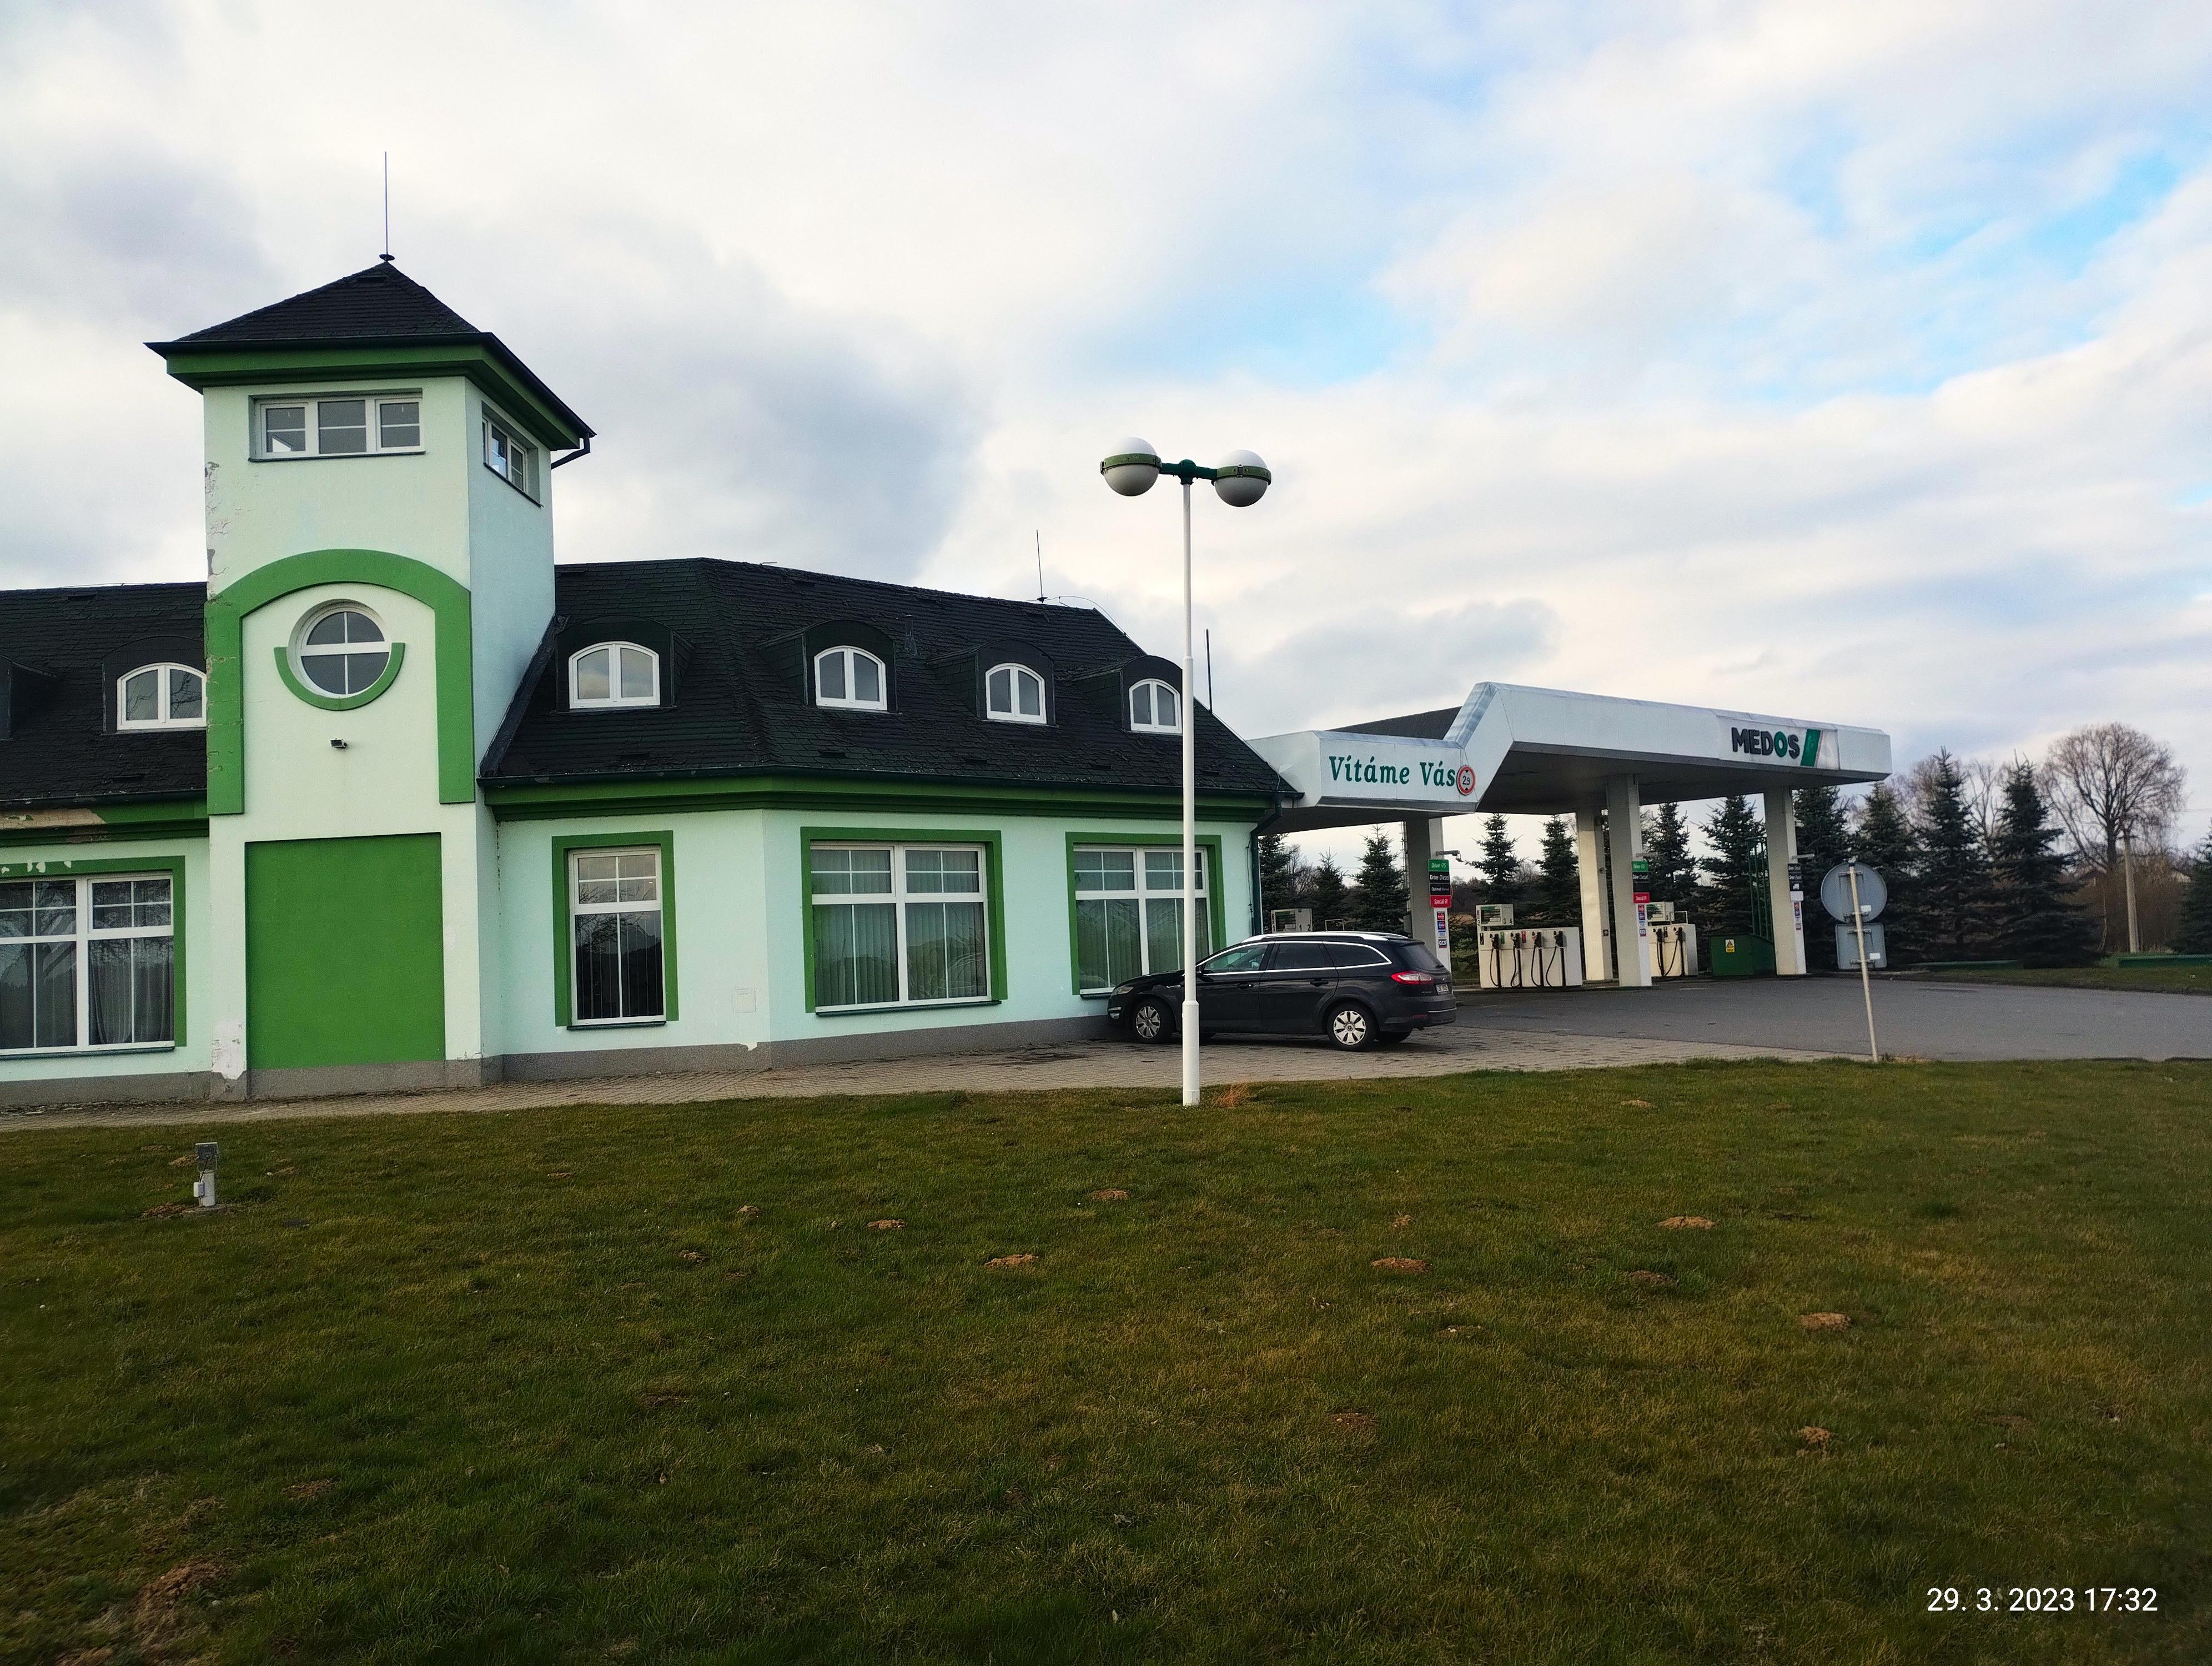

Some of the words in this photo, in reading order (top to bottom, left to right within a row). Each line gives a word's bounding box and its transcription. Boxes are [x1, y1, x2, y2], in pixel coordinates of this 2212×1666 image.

[1731, 727, 1801, 759] MEDOS
[1329, 755, 1410, 785] Vítáme
[1420, 760, 1456, 787] Vás
